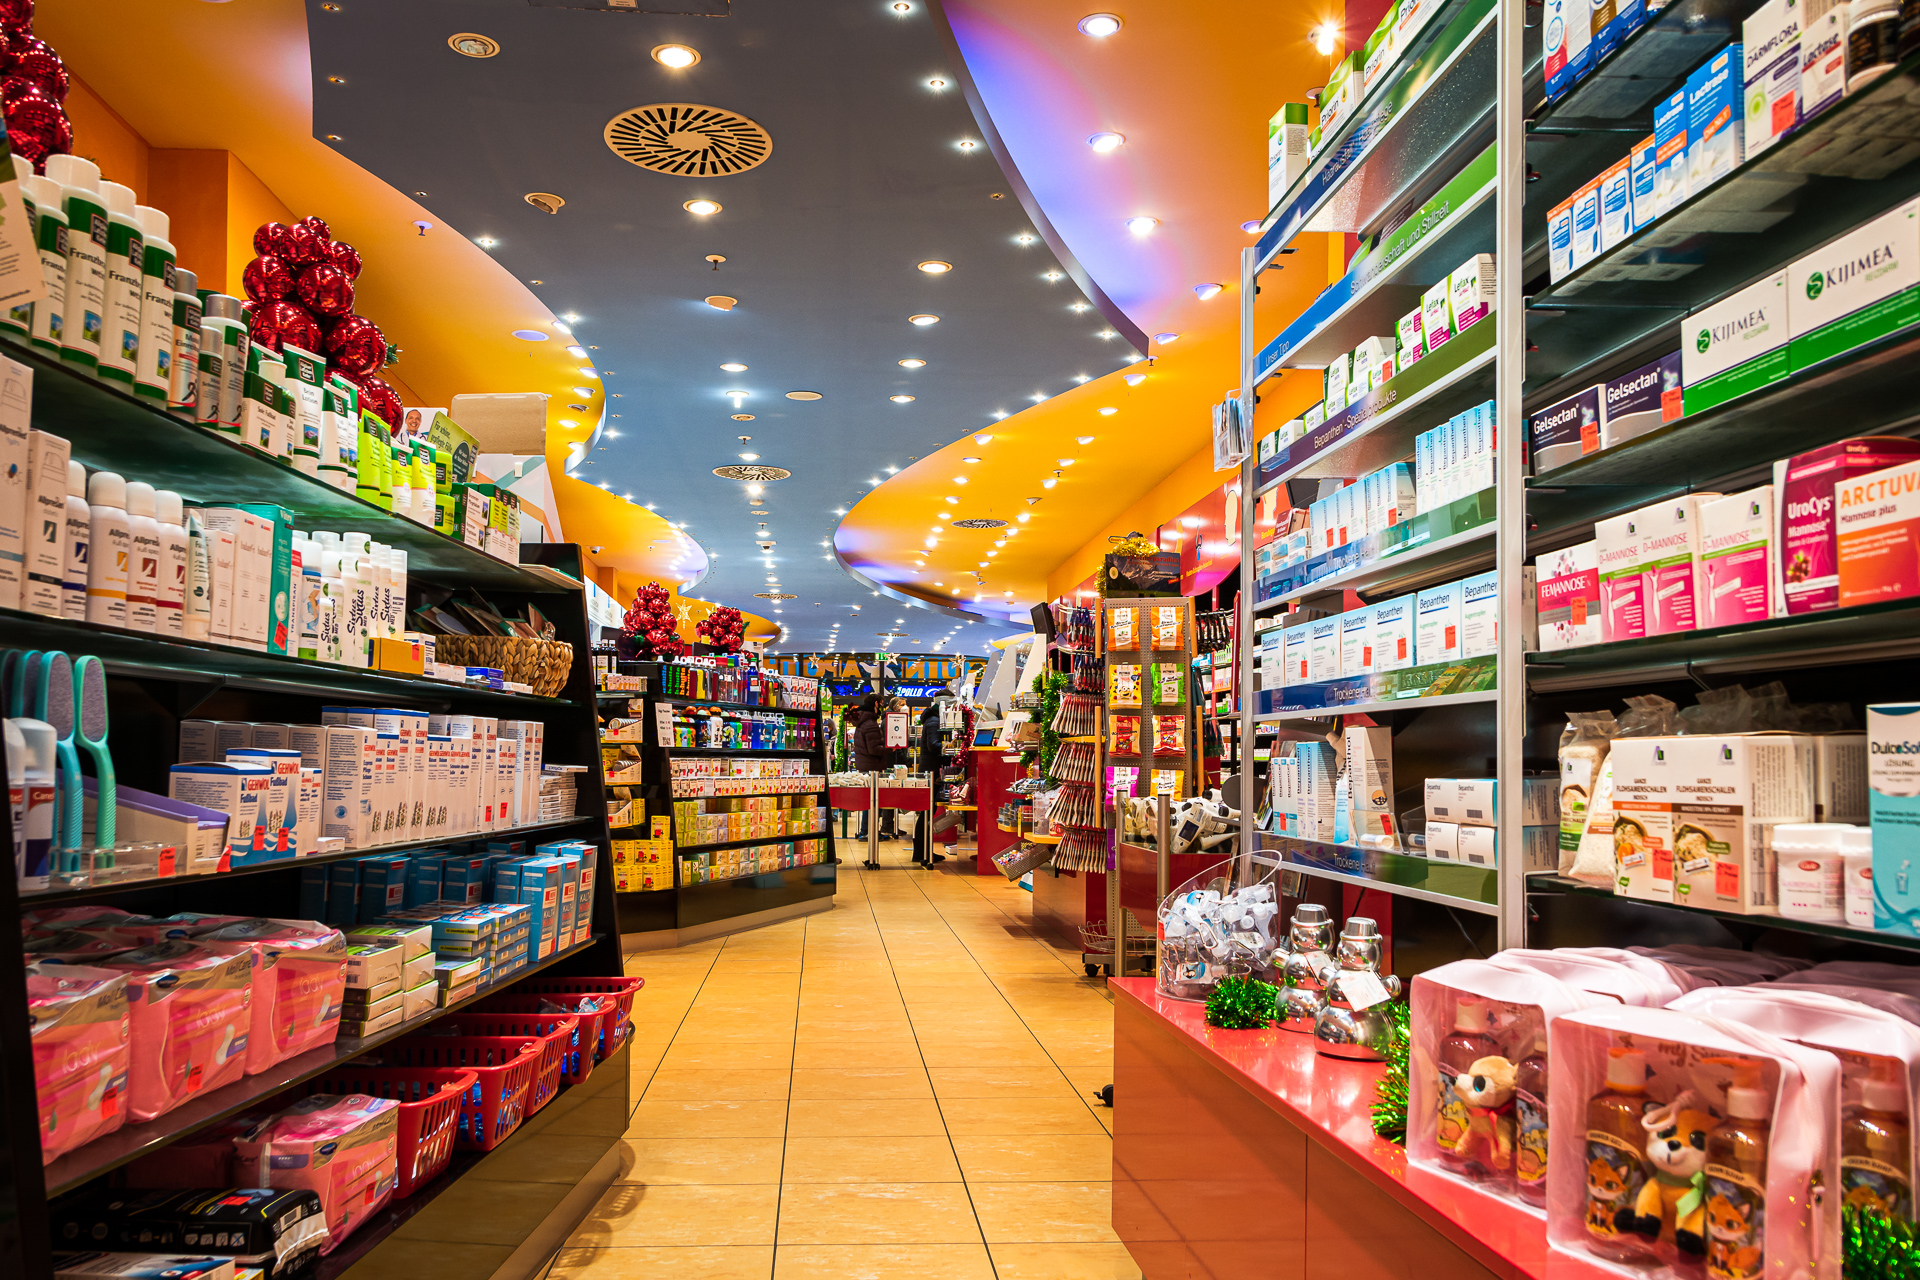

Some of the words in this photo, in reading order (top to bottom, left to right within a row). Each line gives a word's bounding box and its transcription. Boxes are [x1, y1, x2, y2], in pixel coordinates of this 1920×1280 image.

[1747, 21, 1799, 69] DARMFLORA
[1690, 68, 1729, 105] Lactrase
[1406, 229, 1422, 250] und
[1421, 200, 1450, 239] Stillzeit
[1827, 244, 1894, 290] KIJIMEA
[1712, 307, 1766, 345] KIJIMEA
[1265, 349, 1280, 368] Unser
[1878, 504, 1898, 518] plus
[1643, 532, 1688, 553] D-MANNOSE
[1703, 529, 1750, 552] D-MANNOSE
[1600, 545, 1638, 565] D-MANNOSE
[1420, 593, 1450, 610] Bepanthen
[1377, 605, 1403, 620] Bepanthen
[1314, 623, 1335, 635] Bepanthen
[1344, 615, 1368, 629] Bepanthen
[1262, 637, 1280, 648] Bepanthen
[1286, 630, 1306, 642] Bepanthen
[1334, 686, 1360, 701] Trockene
[1676, 785, 1736, 794] FLOHSAMENSCHALEN
[1333, 853, 1360, 871] Trockene
